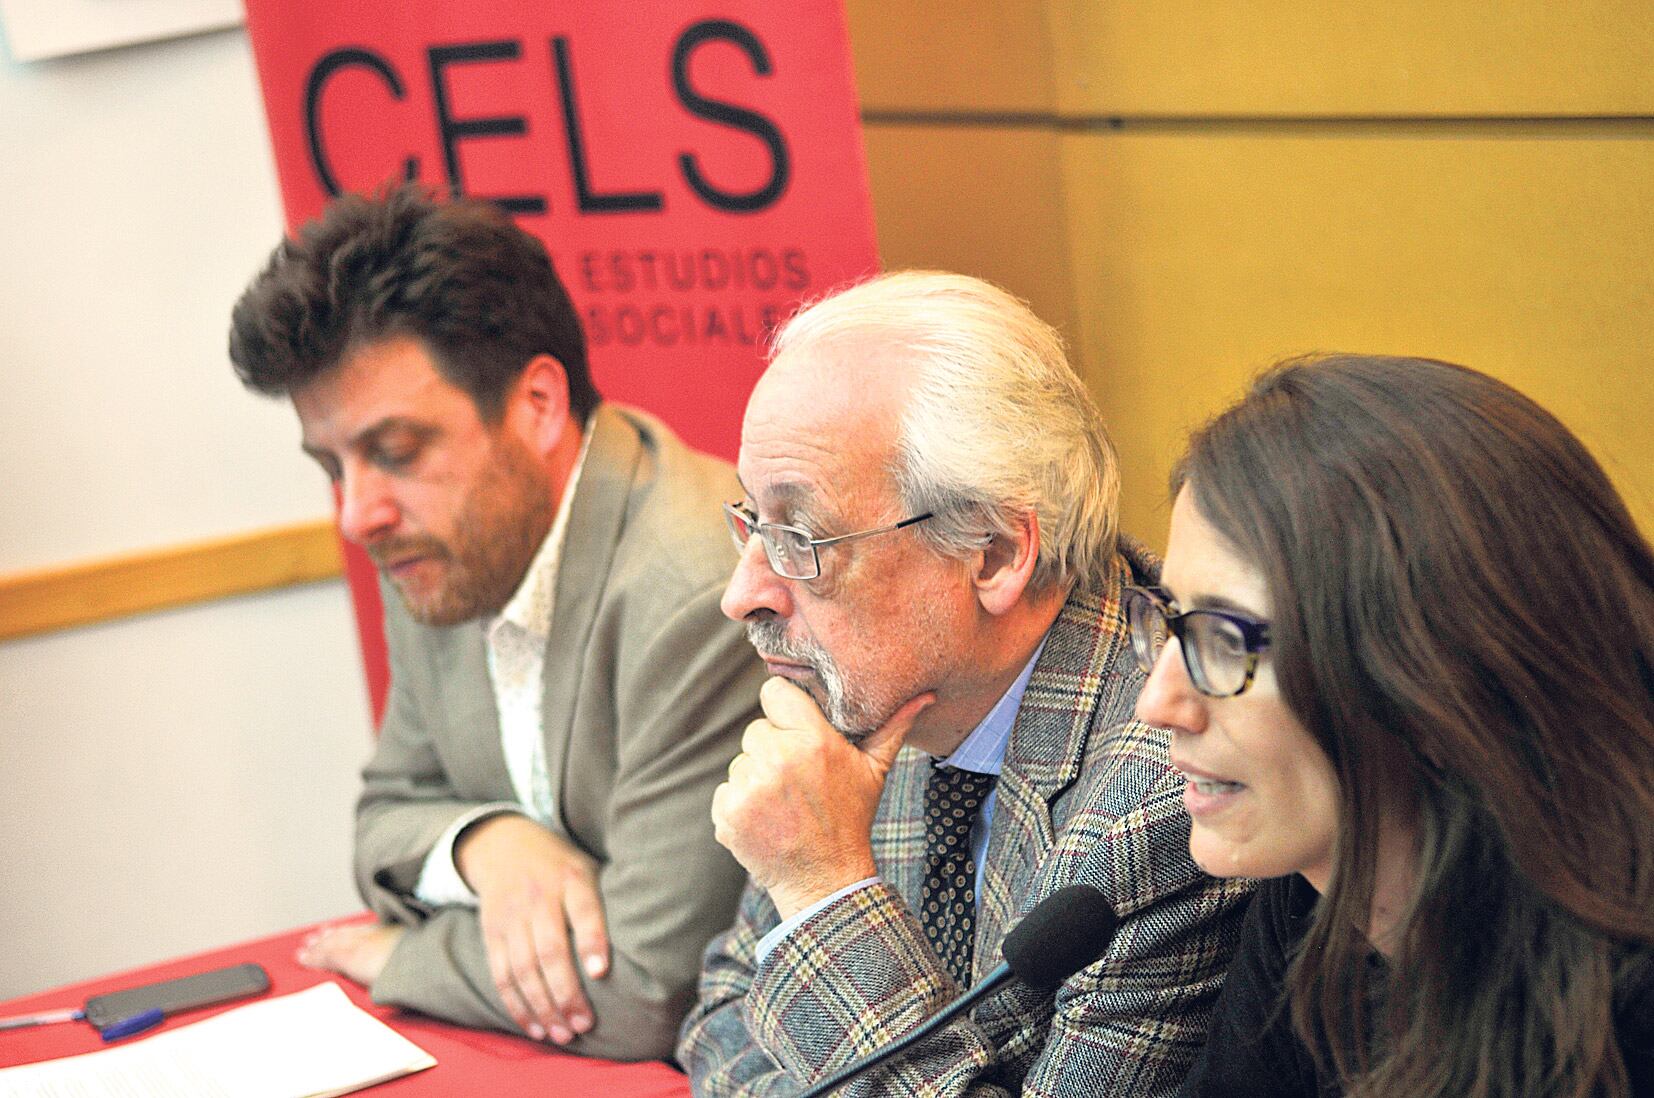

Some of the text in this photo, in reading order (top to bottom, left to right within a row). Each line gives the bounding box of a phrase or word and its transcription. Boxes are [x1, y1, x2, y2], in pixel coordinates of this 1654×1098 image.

[303, 18, 792, 215] CELS
[580, 247, 811, 291] ESTUDIOS
[588, 304, 792, 347] SOCIALE
